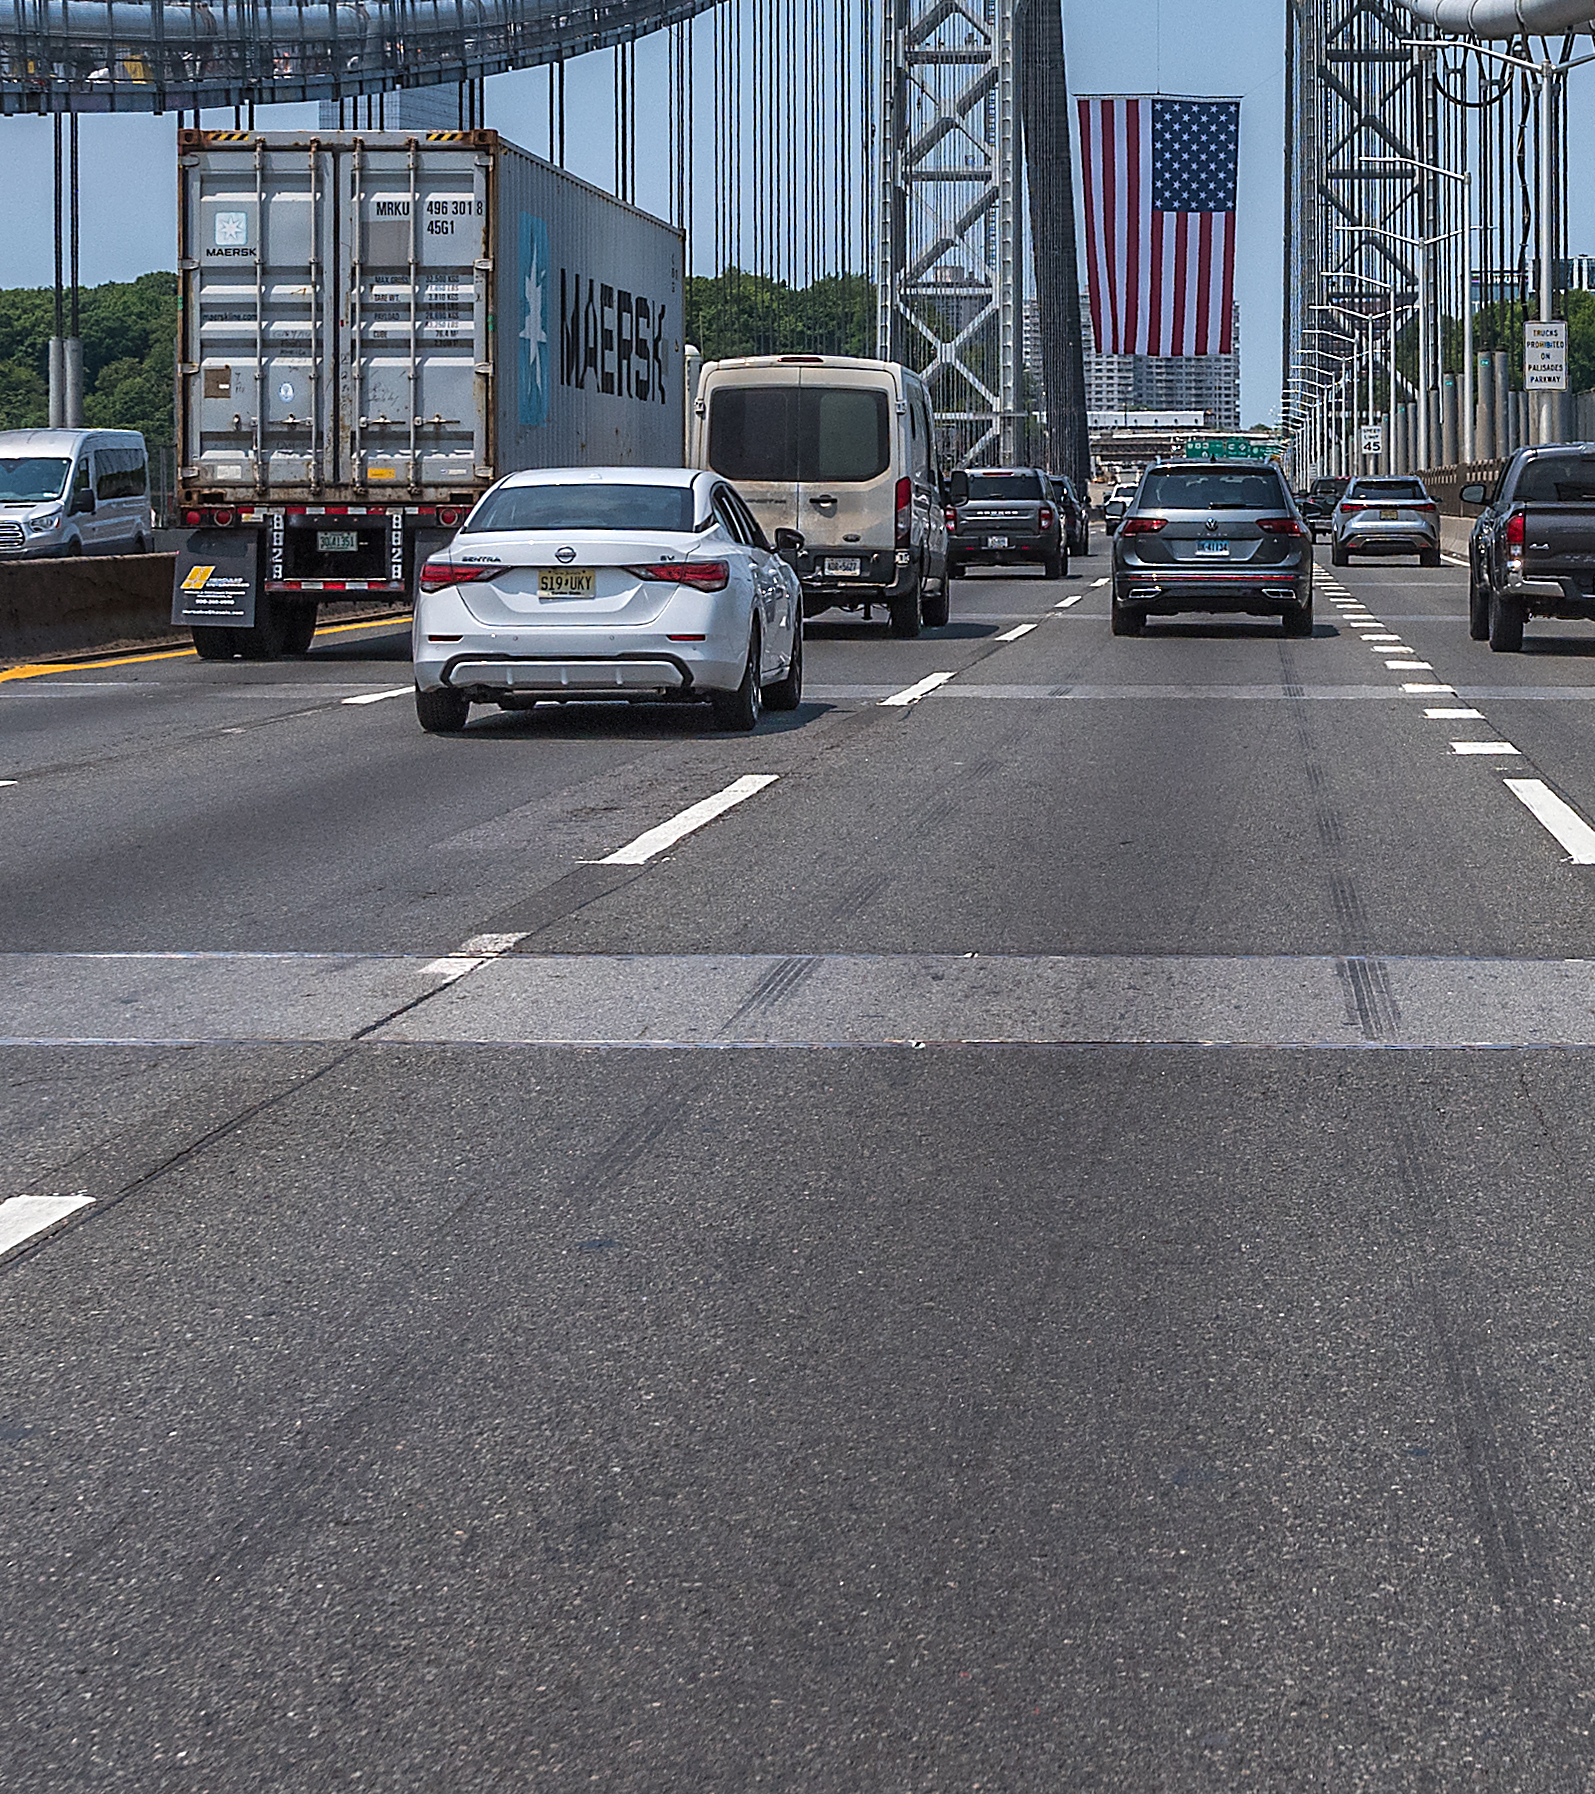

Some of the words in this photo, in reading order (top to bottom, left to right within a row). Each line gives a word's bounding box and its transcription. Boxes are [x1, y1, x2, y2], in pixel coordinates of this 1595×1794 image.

[376, 201, 410, 216] MRKU
[426, 200, 448, 215] 496
[451, 200, 473, 215] 301
[476, 200, 483, 215] 8
[426, 219, 455, 235] 45G1
[206, 248, 257, 257] MAERSK
[202, 311, 258, 322] maerskline.com
[560, 267, 666, 405] MAERSK
[1533, 329, 1558, 337] TRUCKS
[1526, 341, 1565, 349] PROHIBITED
[1540, 352, 1551, 360] ON
[1528, 364, 1563, 372] PALISADES
[1363, 441, 1381, 452] 45
